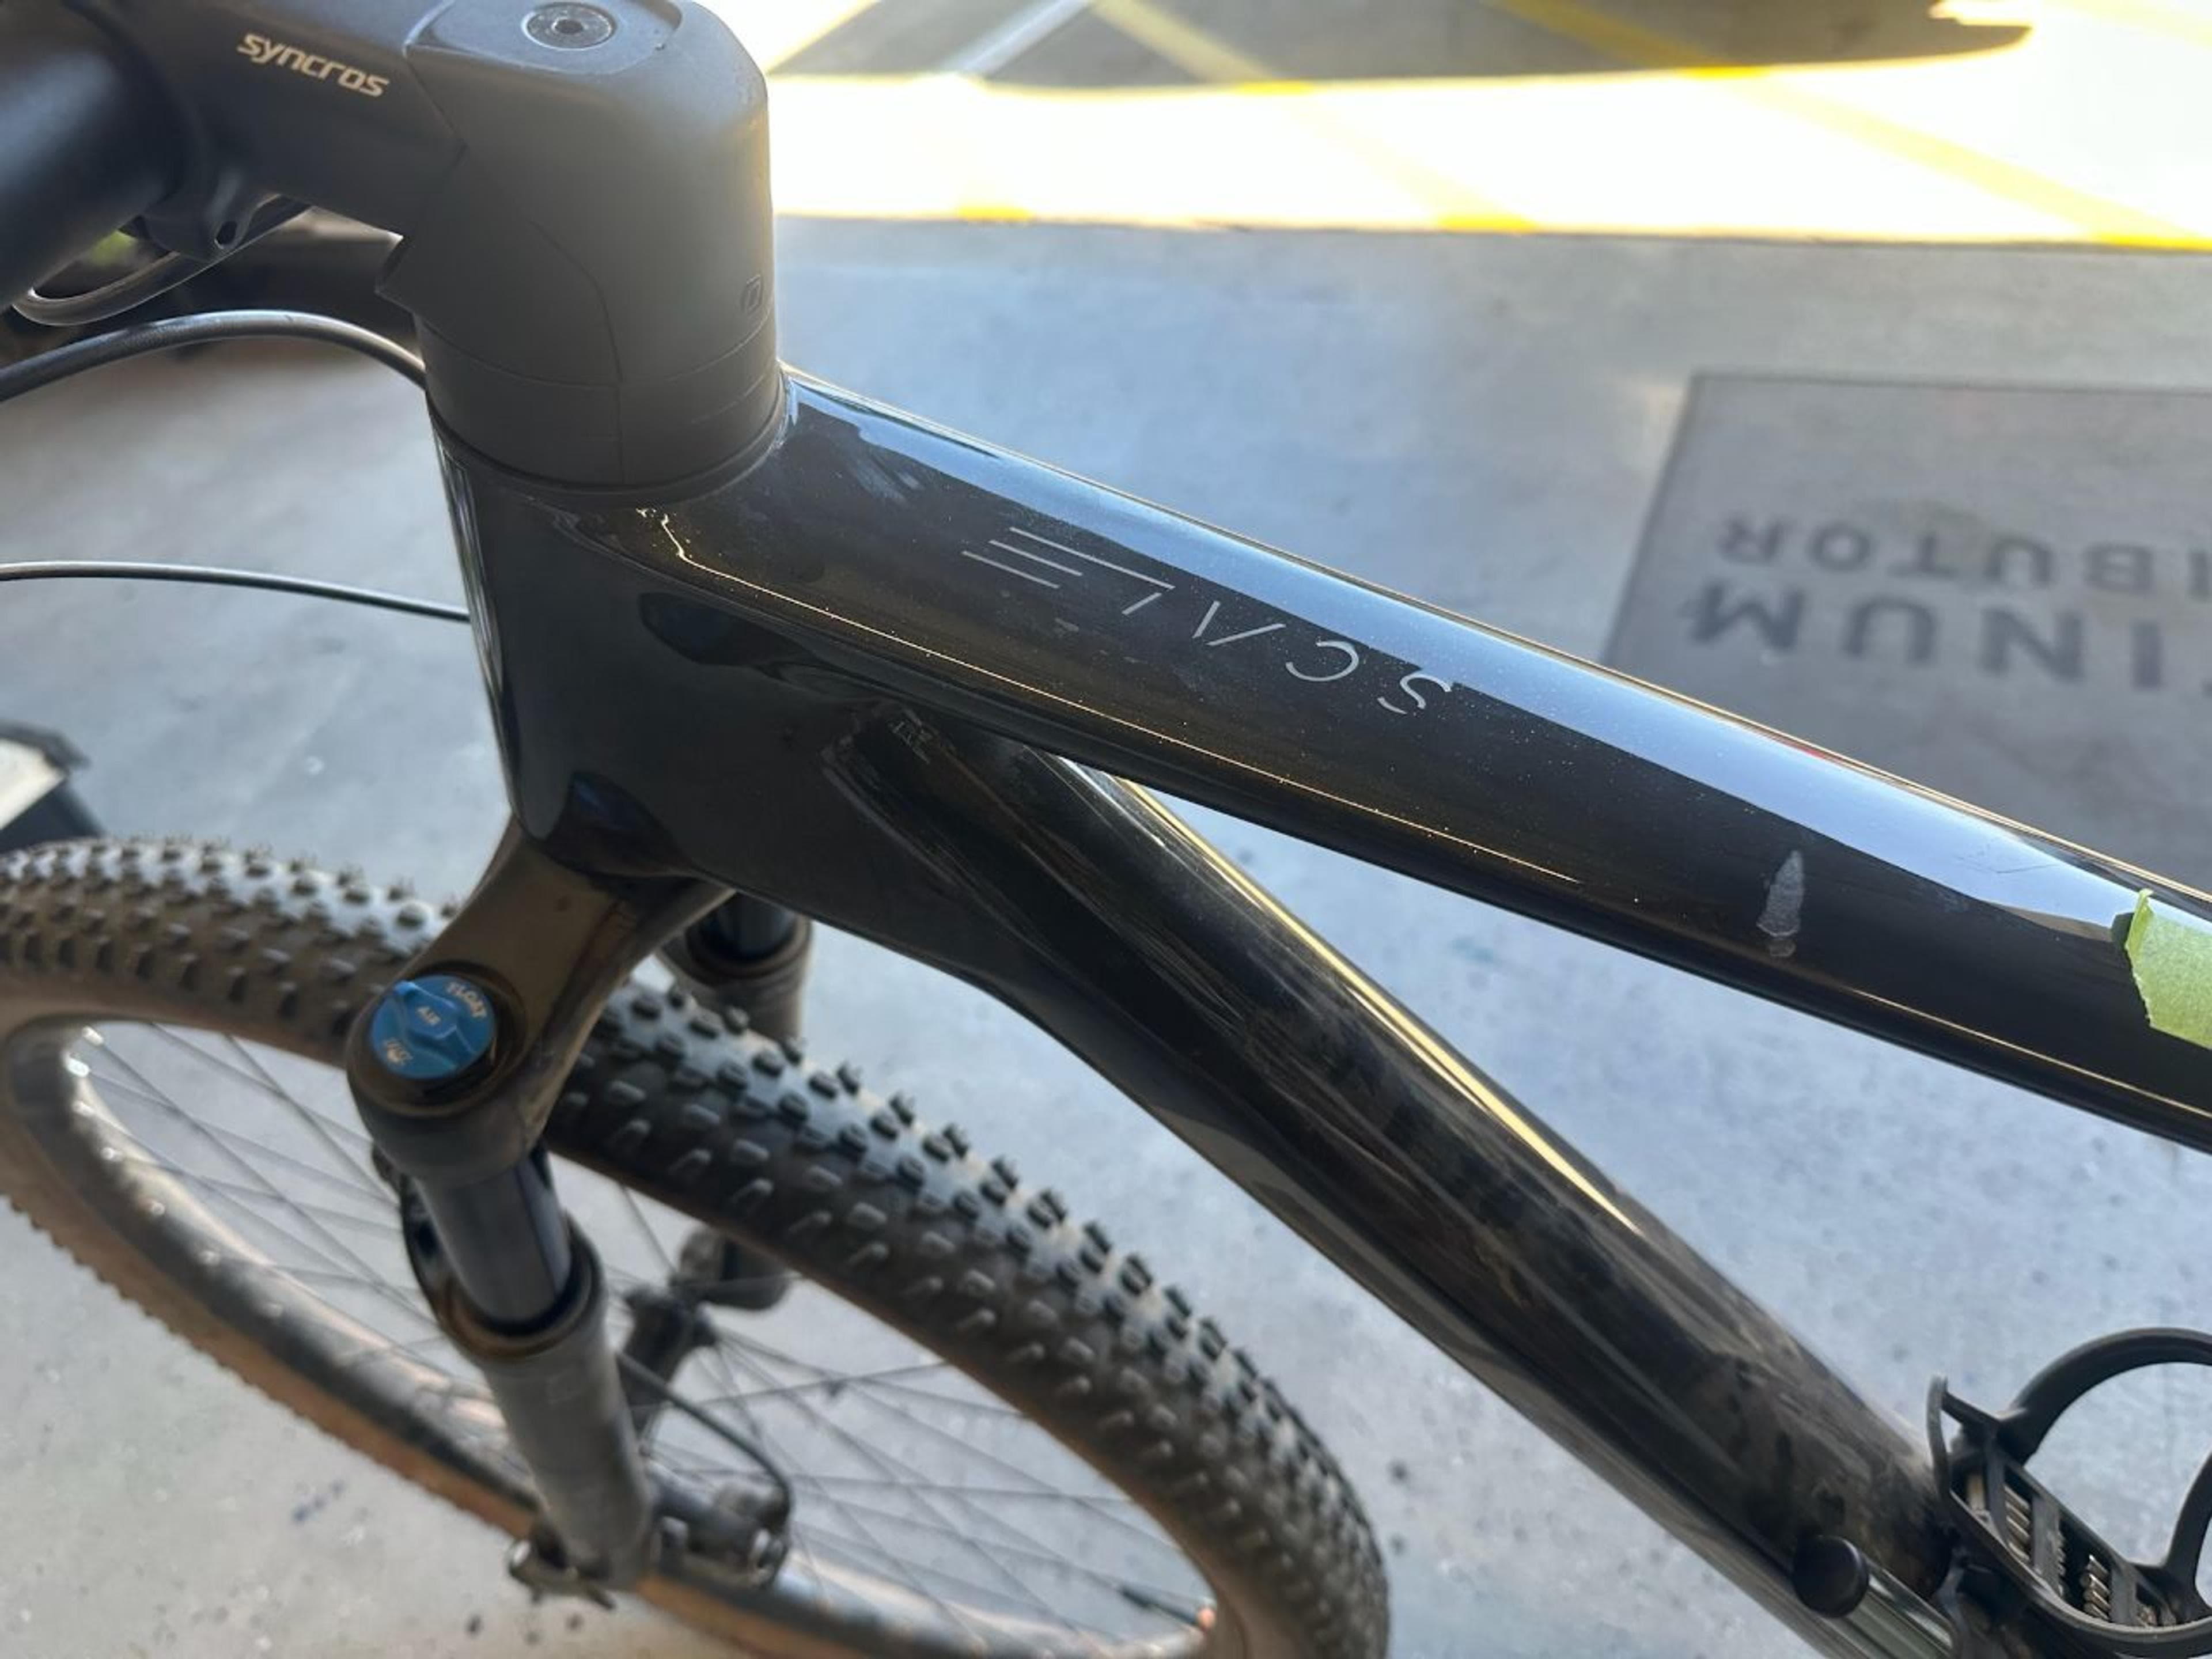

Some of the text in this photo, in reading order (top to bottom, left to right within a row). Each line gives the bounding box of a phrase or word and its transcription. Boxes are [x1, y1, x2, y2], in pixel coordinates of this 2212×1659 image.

[237, 33, 389, 97] syncros
[962, 527, 1450, 715] SCALE
[1682, 581, 2212, 697] INUM
